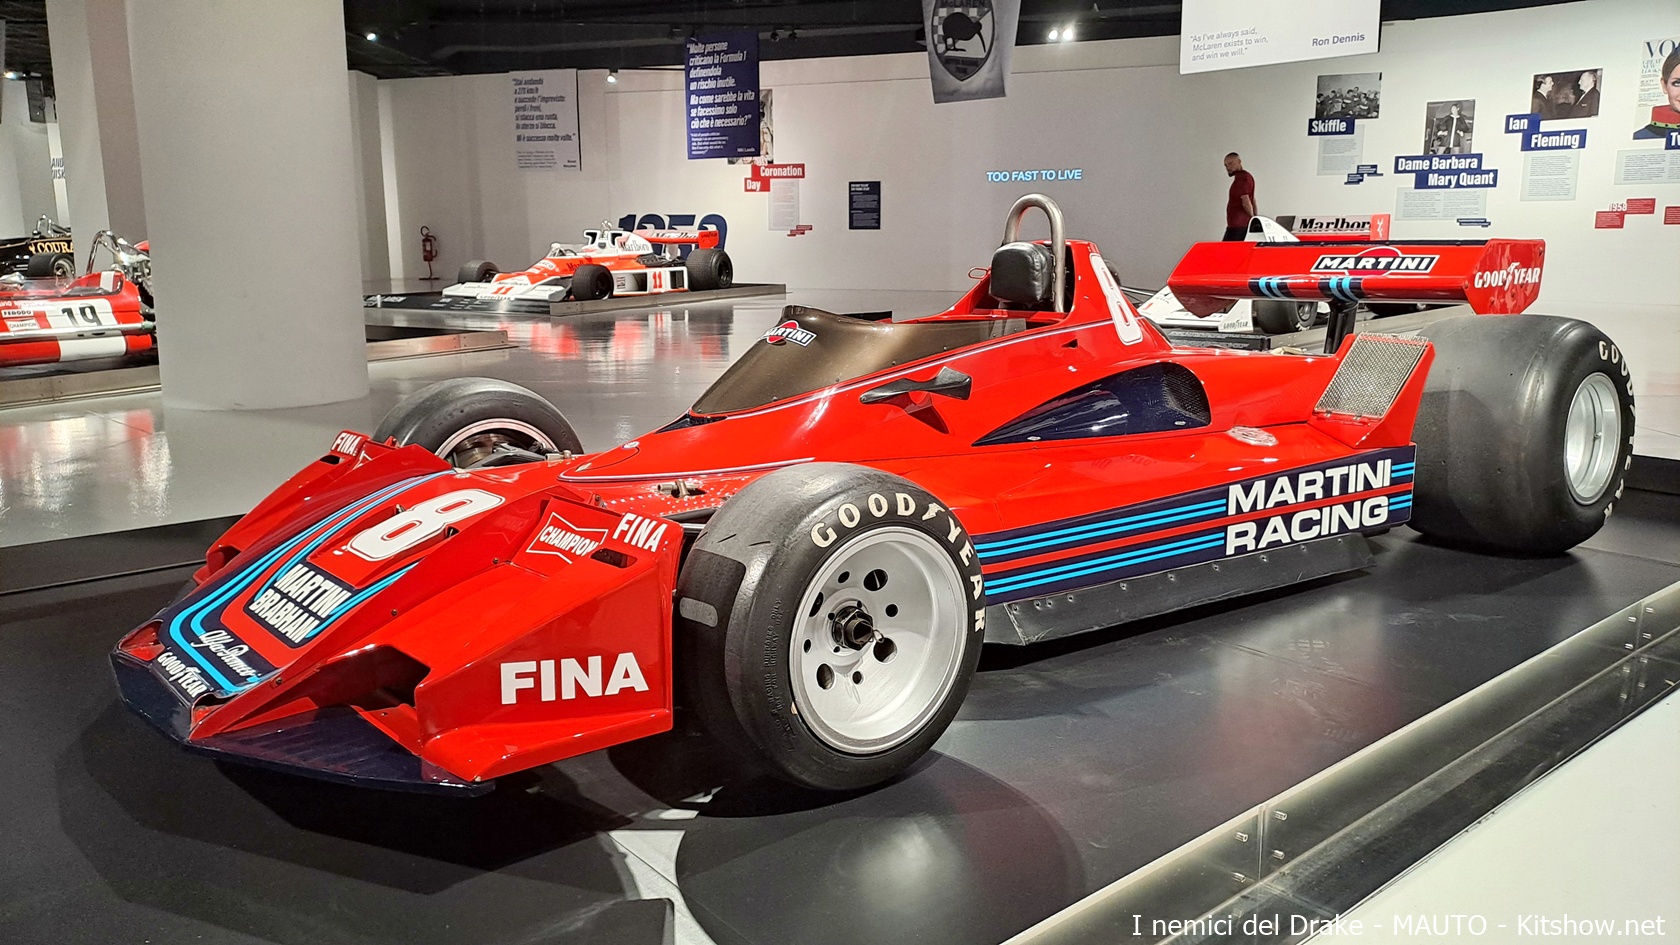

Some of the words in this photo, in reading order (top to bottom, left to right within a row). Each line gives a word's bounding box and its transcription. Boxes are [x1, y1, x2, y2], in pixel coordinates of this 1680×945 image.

[1203, 33, 1214, 41] I've
[1216, 30, 1239, 39] always
[1241, 27, 1257, 36] said,
[1312, 37, 1330, 47] Ron
[1332, 32, 1365, 45] Dennis
[705, 41, 728, 54] persone
[1193, 42, 1222, 51] McLaren
[1224, 39, 1243, 48] exists
[1254, 36, 1268, 44] win,
[1643, 39, 1680, 58] VO
[689, 54, 713, 66] criticano
[714, 53, 719, 64] la
[720, 51, 743, 63] Formula
[1192, 52, 1204, 61] and
[1206, 51, 1218, 59] win
[689, 65, 722, 78] definendola
[690, 81, 697, 90] un
[698, 78, 716, 89] rischio
[690, 94, 698, 105] Ma
[699, 94, 714, 104] come
[714, 92, 737, 102] sarebbe
[737, 91, 743, 101] la
[744, 90, 755, 100] vita
[690, 107, 697, 117] se
[697, 105, 725, 116] facessimo
[726, 104, 738, 114] solo
[700, 118, 709, 128] che
[1311, 119, 1347, 133] Skiffle
[1509, 117, 1528, 131] Ian
[1531, 133, 1580, 149] Fleming
[760, 165, 803, 177] Coronation
[1398, 158, 1430, 171] Dame
[1432, 156, 1478, 170] Barbara
[986, 171, 1009, 182] TOO
[1012, 170, 1039, 181] FAST
[1040, 170, 1056, 181] TO
[1058, 169, 1082, 180] LIVE
[1428, 173, 1457, 188] Mary
[1459, 173, 1494, 186] Quant
[746, 179, 761, 192] Day
[1318, 257, 1433, 270] MARTINI
[652, 271, 663, 289] 11
[1474, 262, 1541, 290] GOODYEAR
[492, 286, 515, 295] 11
[61, 305, 103, 327] 19
[1223, 320, 1249, 329] GOODYEAR
[331, 432, 362, 455] FINA
[1228, 458, 1392, 516] MARTINI
[347, 488, 506, 562] 8
[612, 512, 668, 552] FINA
[1226, 496, 1389, 556] RACING
[539, 525, 600, 556] CHAMPION
[810, 492, 987, 633] GOODYEAR
[273, 563, 352, 619] MARTINI
[248, 589, 321, 644] BRABHAM
[190, 629, 234, 655] Alfa
[157, 651, 208, 698] GOODYEAR
[500, 651, 650, 705] FINA
